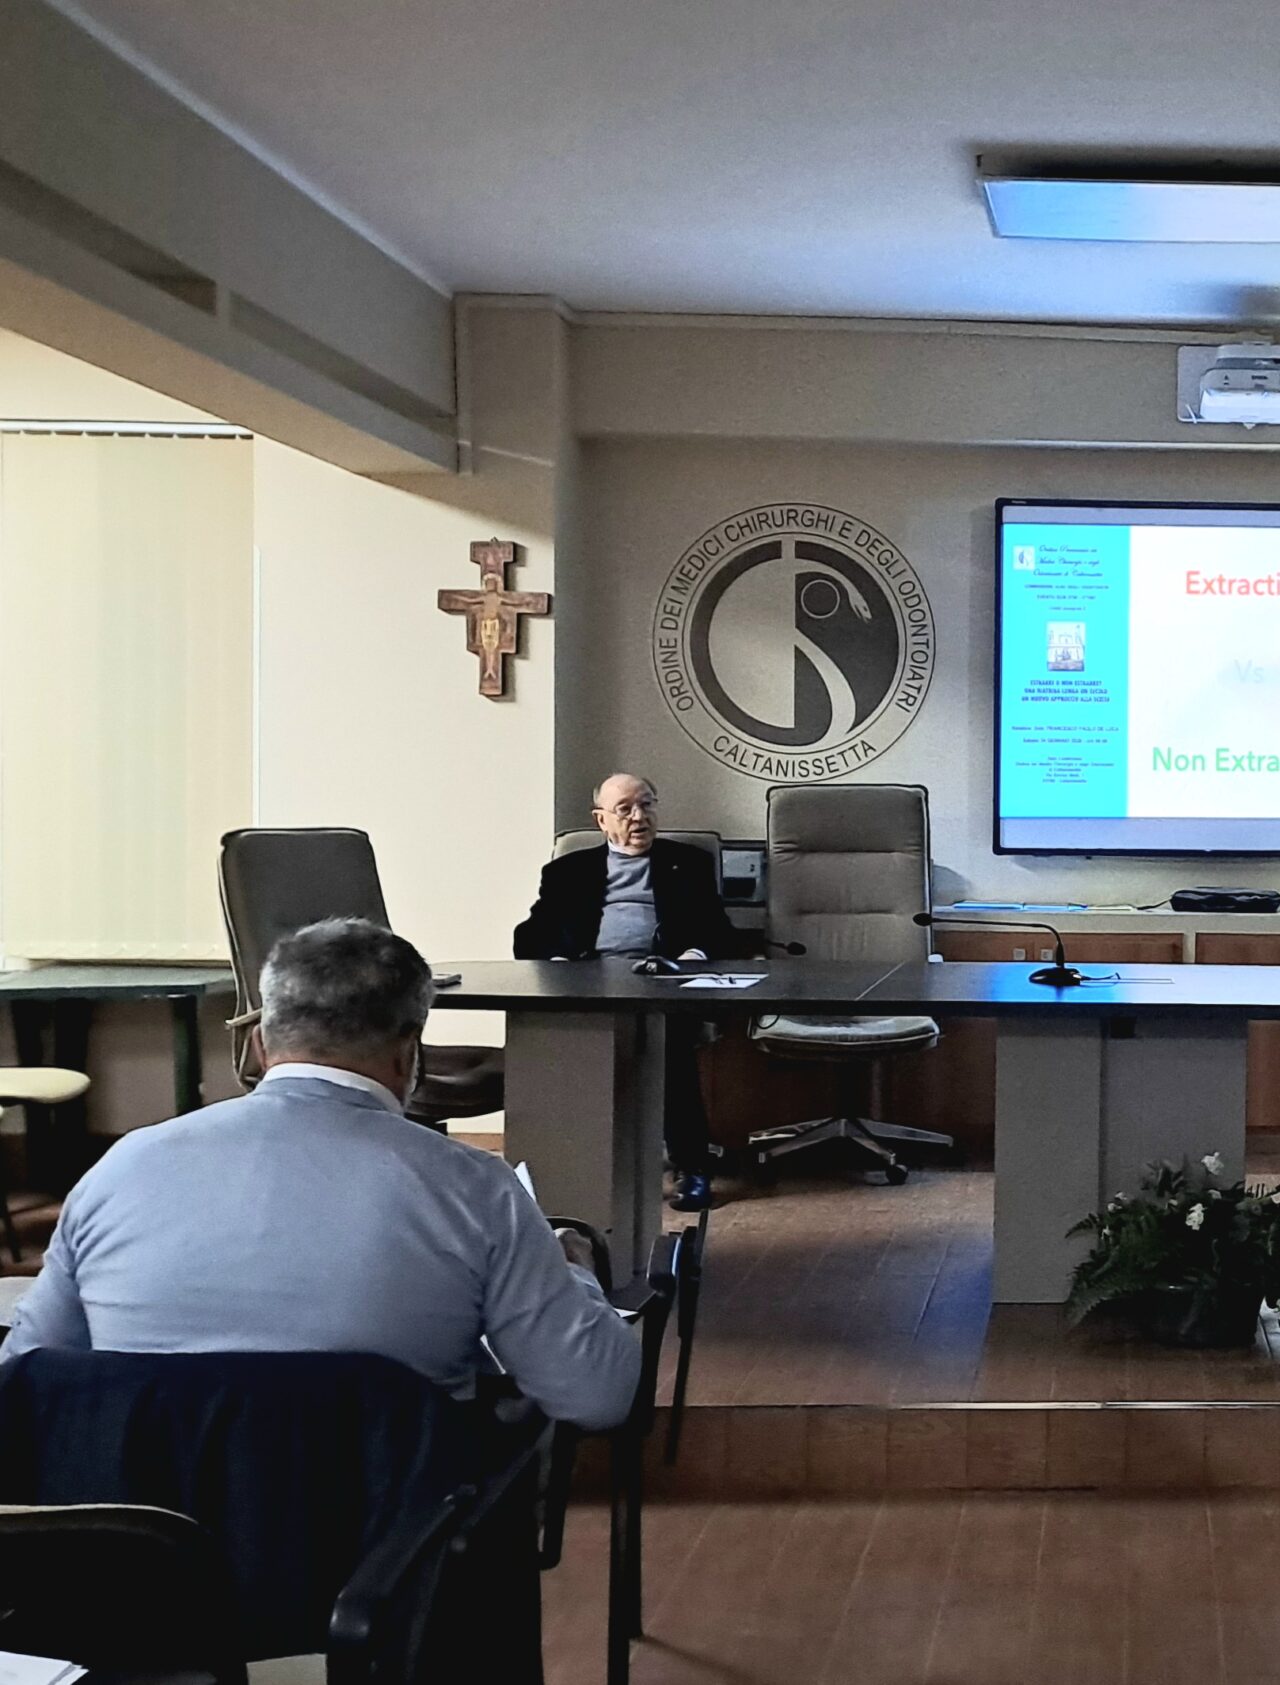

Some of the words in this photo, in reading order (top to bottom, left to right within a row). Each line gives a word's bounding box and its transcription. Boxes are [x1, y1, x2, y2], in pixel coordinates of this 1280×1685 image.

[723, 508, 835, 543] CHIRURGHI
[838, 520, 854, 539] E
[670, 534, 725, 595] MEDICI
[854, 528, 907, 580] DEGLI
[660, 597, 683, 631] DEI
[895, 580, 930, 713] ODONTOIATRI
[659, 636, 694, 712] ORDINE
[1233, 659, 1265, 684] Vs
[713, 735, 877, 778] CALTANISSETTA
[1152, 747, 1206, 772] Non
